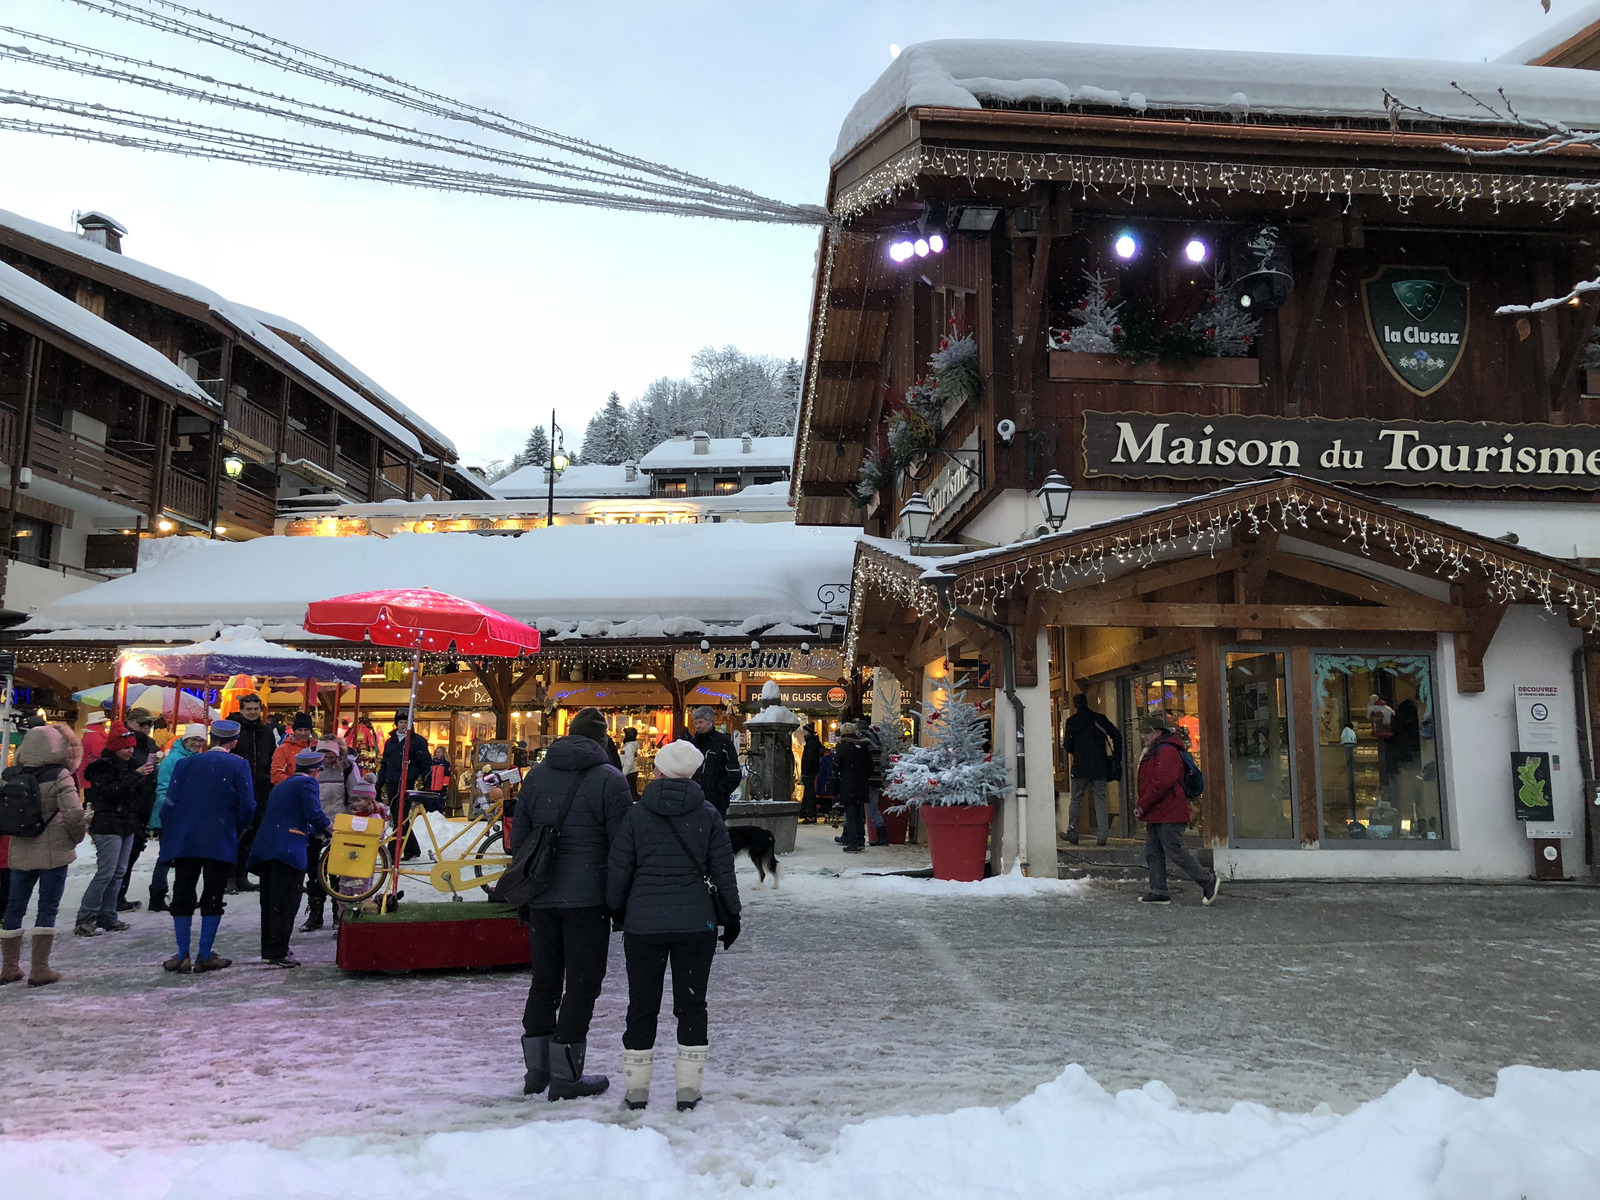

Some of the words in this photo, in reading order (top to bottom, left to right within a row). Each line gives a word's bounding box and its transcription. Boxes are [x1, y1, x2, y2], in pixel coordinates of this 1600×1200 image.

[1384, 325, 1401, 343] la
[1403, 326, 1460, 345] Clusaz
[1111, 421, 1301, 467] Maison
[1320, 439, 1364, 469] du
[926, 459, 970, 521] Tourisme
[714, 652, 792, 671] PASSION
[792, 692, 823, 702] GLISSE
